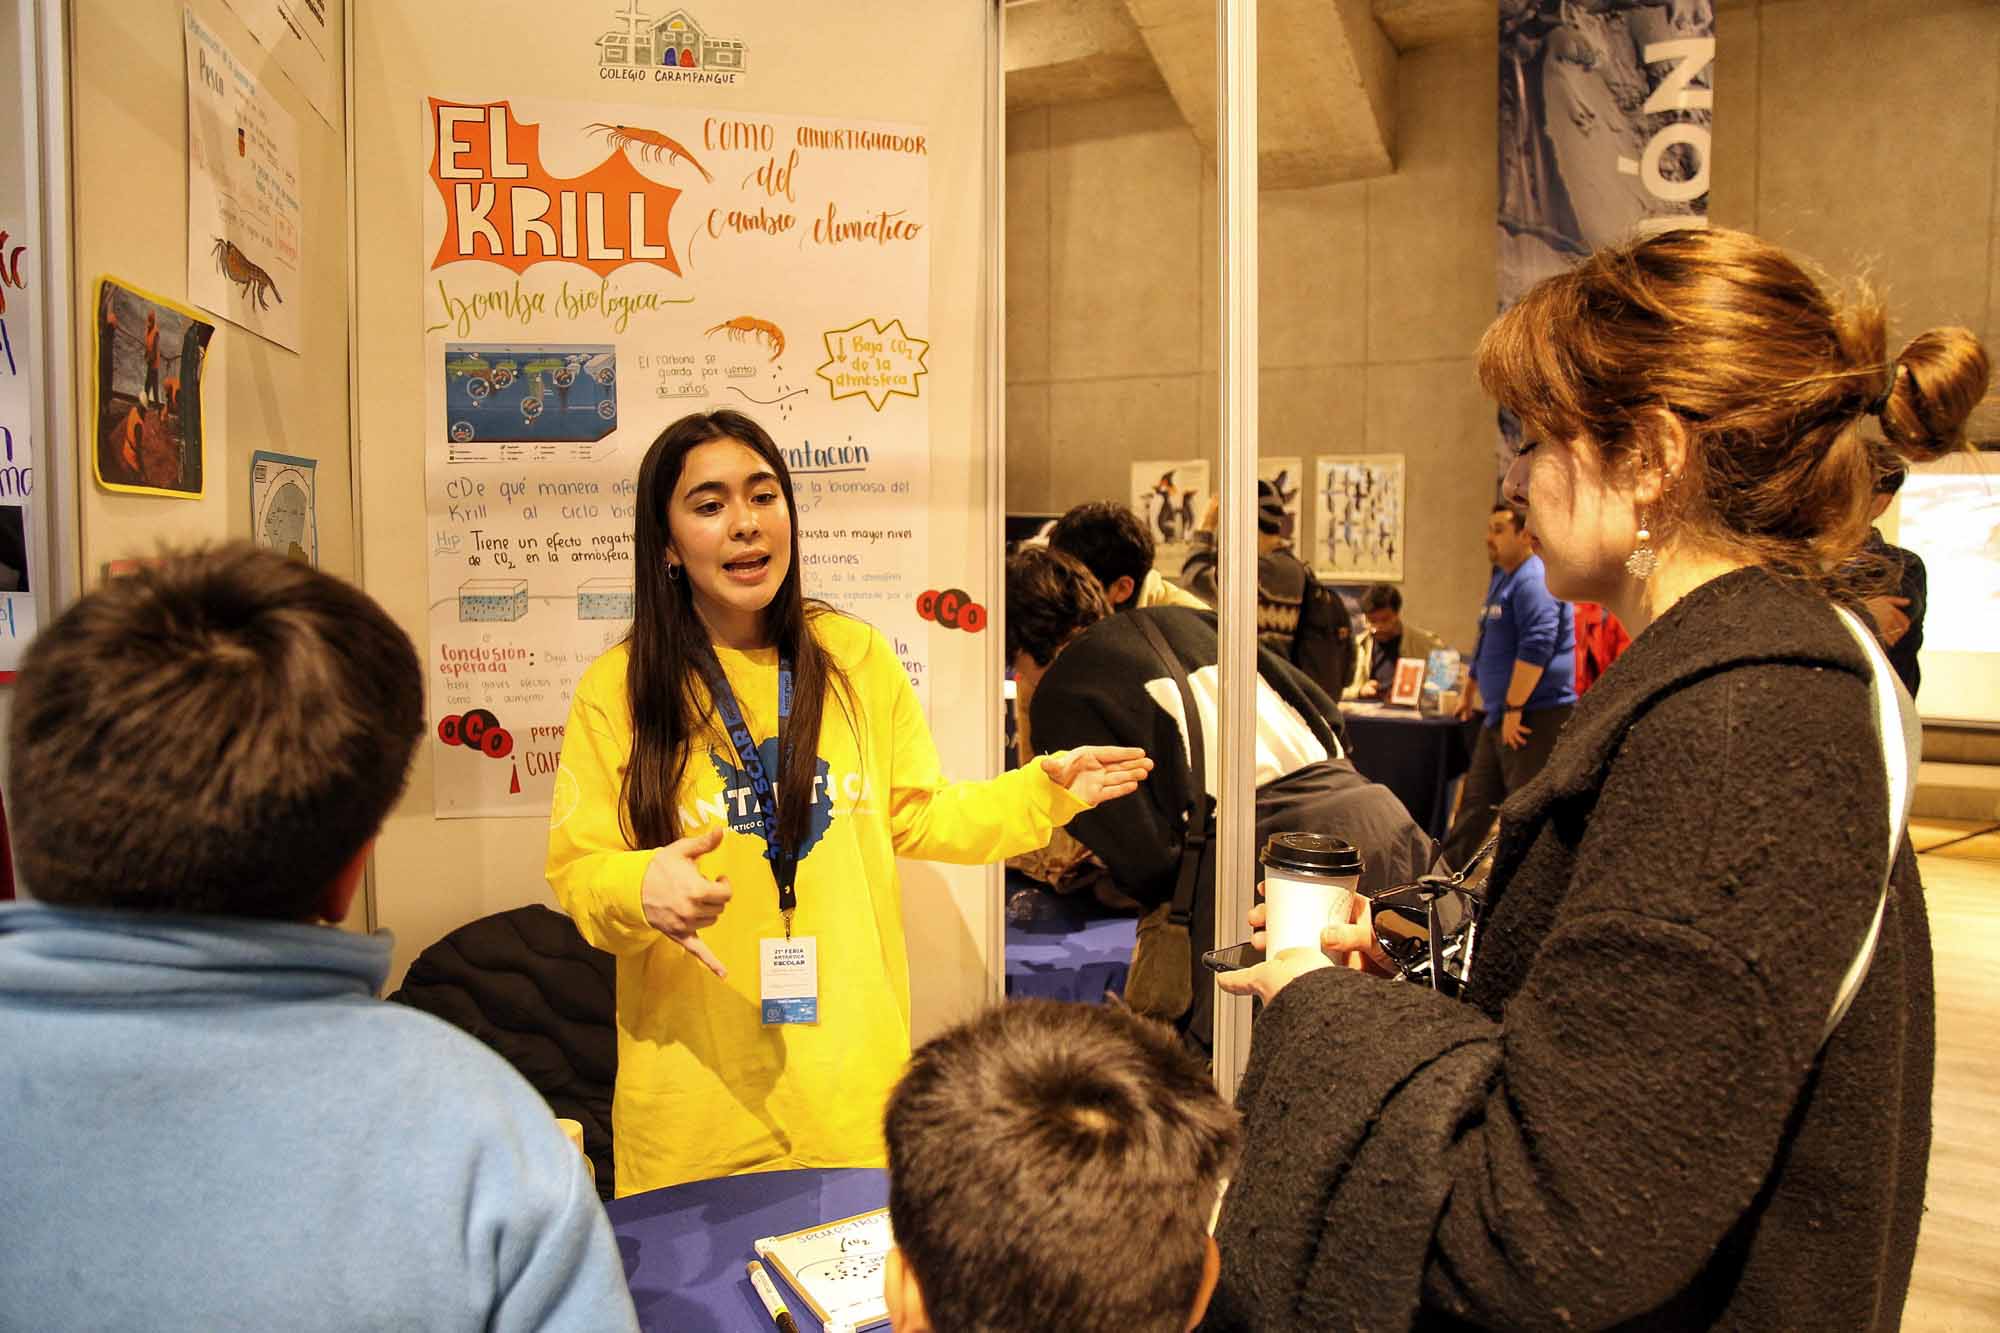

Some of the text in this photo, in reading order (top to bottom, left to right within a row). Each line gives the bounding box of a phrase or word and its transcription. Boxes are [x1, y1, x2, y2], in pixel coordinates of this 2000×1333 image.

[599, 67, 736, 84] COLEGIO CARAMPANGUE
[437, 105, 529, 179] EL
[746, 149, 799, 202] del
[455, 183, 667, 260] KRILL
[437, 280, 545, 338] bomba
[852, 357, 892, 371] de la
[701, 367, 719, 380] por
[500, 476, 527, 504] qué
[538, 481, 599, 496] manera
[811, 481, 822, 493] la
[830, 480, 886, 494] biomasa
[890, 481, 910, 493] del
[448, 505, 488, 524] Krill
[523, 505, 538, 521] al
[562, 504, 599, 520] ciclo
[470, 530, 509, 550] Tiene
[518, 535, 538, 549] un
[546, 532, 582, 552] efecto
[832, 529, 847, 538] un
[851, 529, 884, 544] mayor
[887, 529, 912, 539] nivel
[468, 554, 481, 567] de
[526, 552, 540, 564] en
[548, 551, 559, 563] la
[800, 553, 859, 565] ediciones
[440, 661, 508, 678] esperada
